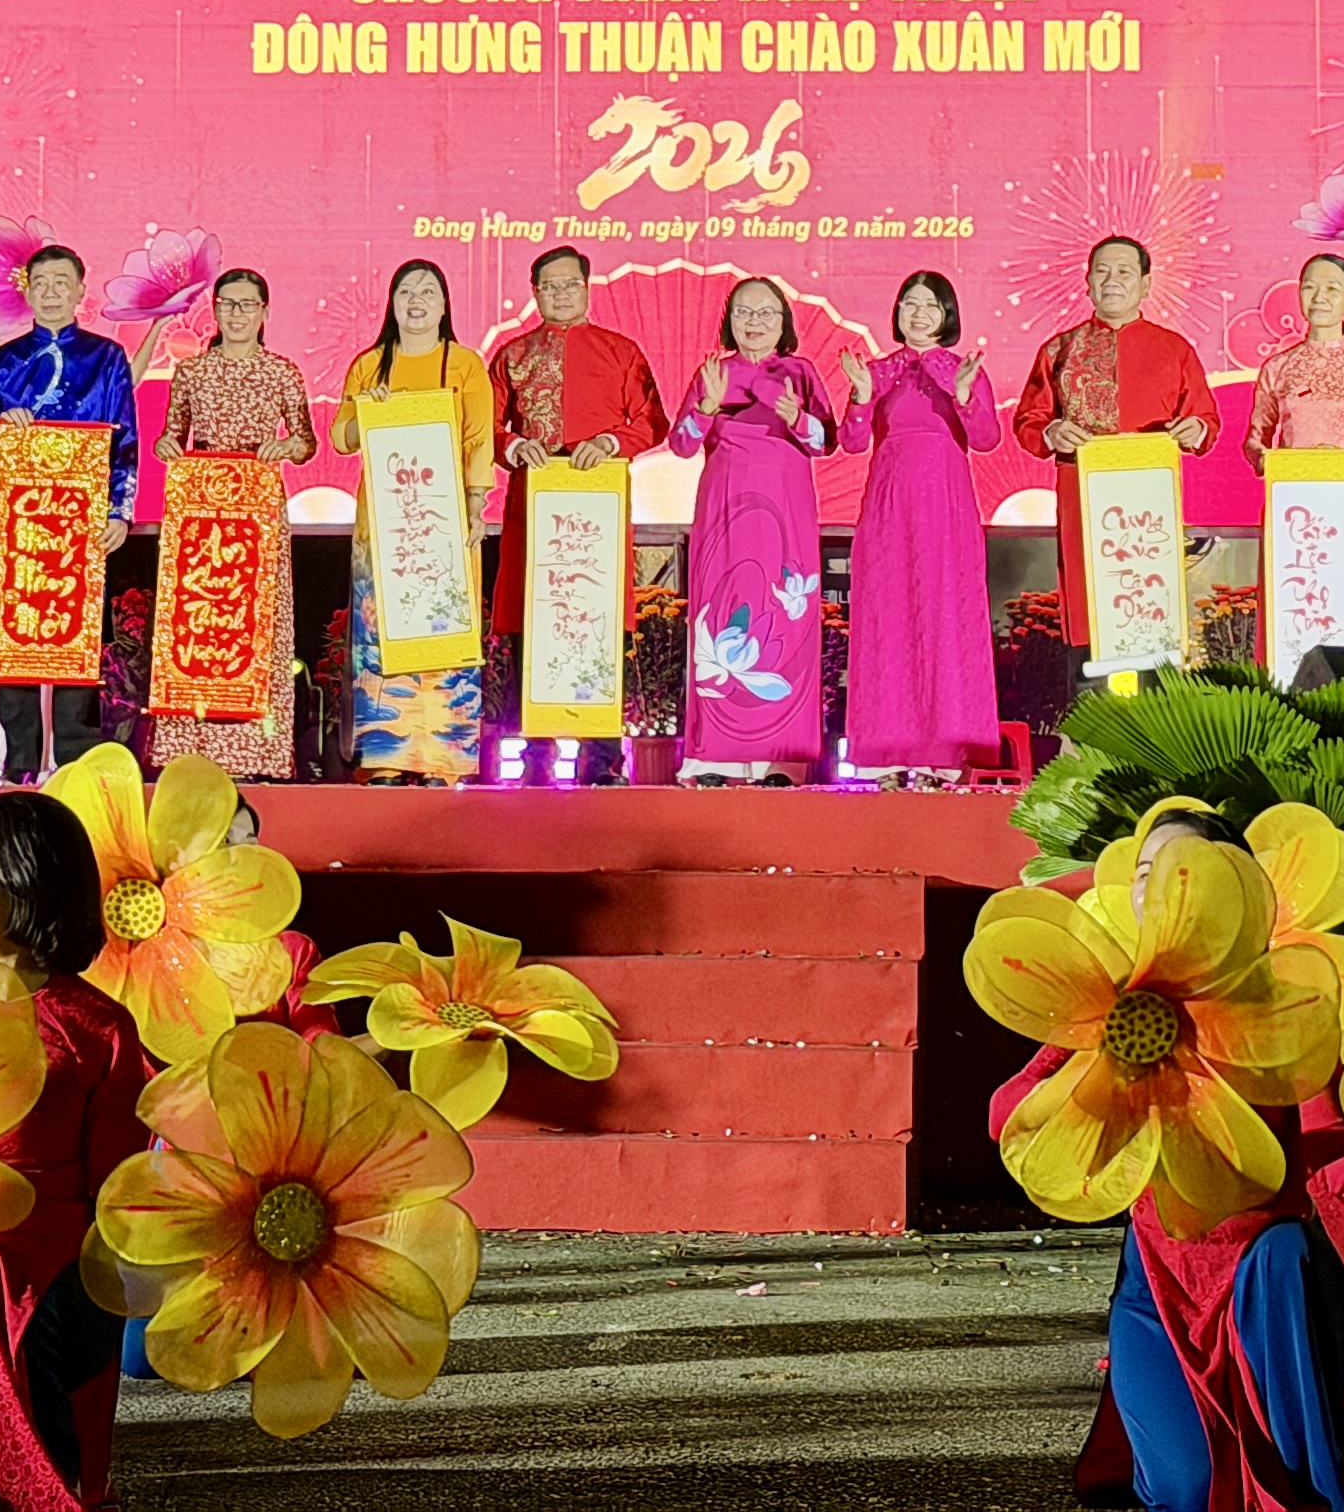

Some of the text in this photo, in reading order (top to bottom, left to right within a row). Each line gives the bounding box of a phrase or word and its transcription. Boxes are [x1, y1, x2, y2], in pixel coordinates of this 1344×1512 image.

[250, 10, 1140, 82] ĐÔNG HƯNG THUẬN CHÀO XUÂN MỚI
[576, 91, 812, 212] 2026
[413, 214, 974, 243] Đông Hưng Thuận, ngày 09 tháng 02 năm 2026
[1101, 505, 1171, 544] Cung
[1283, 542, 1334, 575] Lộc
